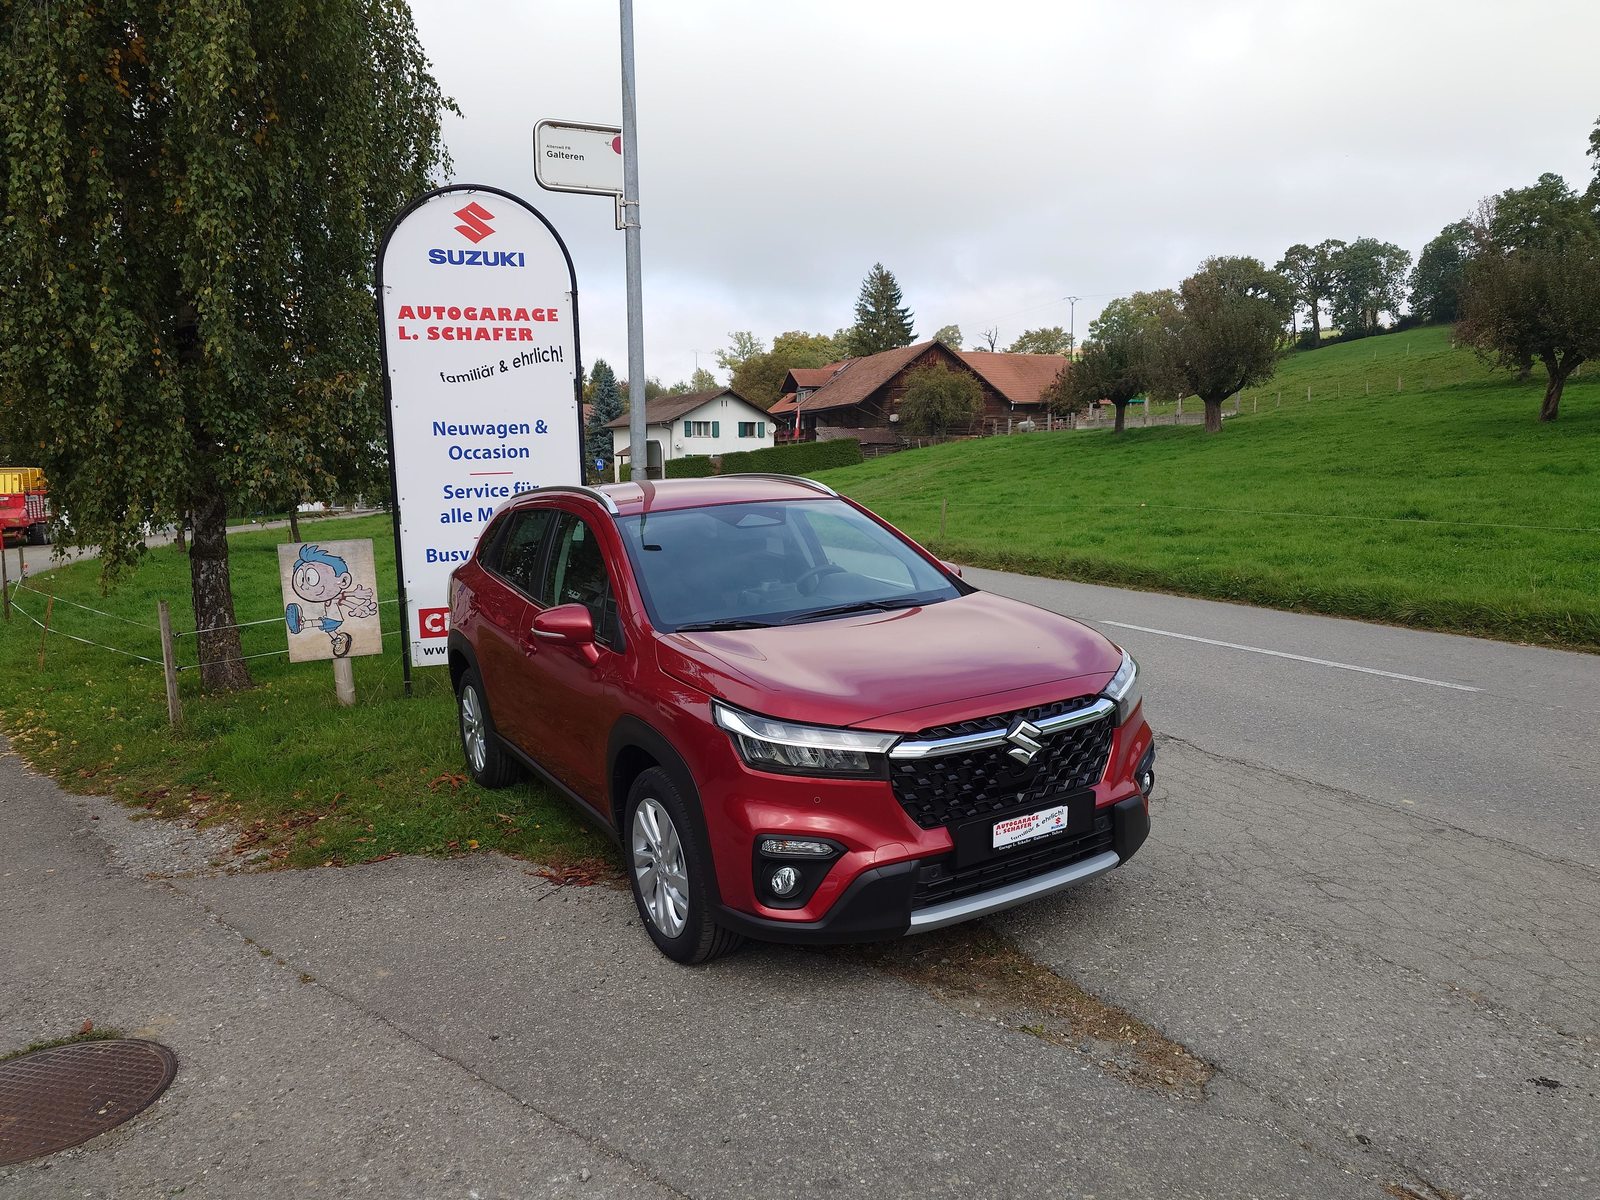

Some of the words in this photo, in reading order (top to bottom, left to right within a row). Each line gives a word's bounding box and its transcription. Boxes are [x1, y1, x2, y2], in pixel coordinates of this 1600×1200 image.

[546, 150, 585, 161] Galteren
[428, 248, 525, 267] SUZUKI
[398, 305, 559, 322] AUTOGARAGE
[398, 326, 419, 340] L.
[427, 326, 534, 341] SCHAFER
[439, 365, 495, 384] familiär
[499, 360, 509, 373] &
[512, 345, 564, 369] ehrlich!
[432, 420, 530, 439] Neuwagen
[535, 419, 548, 434] &
[448, 444, 530, 461] Occasion
[443, 482, 510, 500] Service
[440, 508, 473, 524] alle
[478, 507, 493, 522] M
[426, 548, 472, 564] Busv
[423, 646, 449, 656] ww
[996, 814, 1039, 830] AUTOGARAGE
[1003, 822, 1032, 834] SCHAFER
